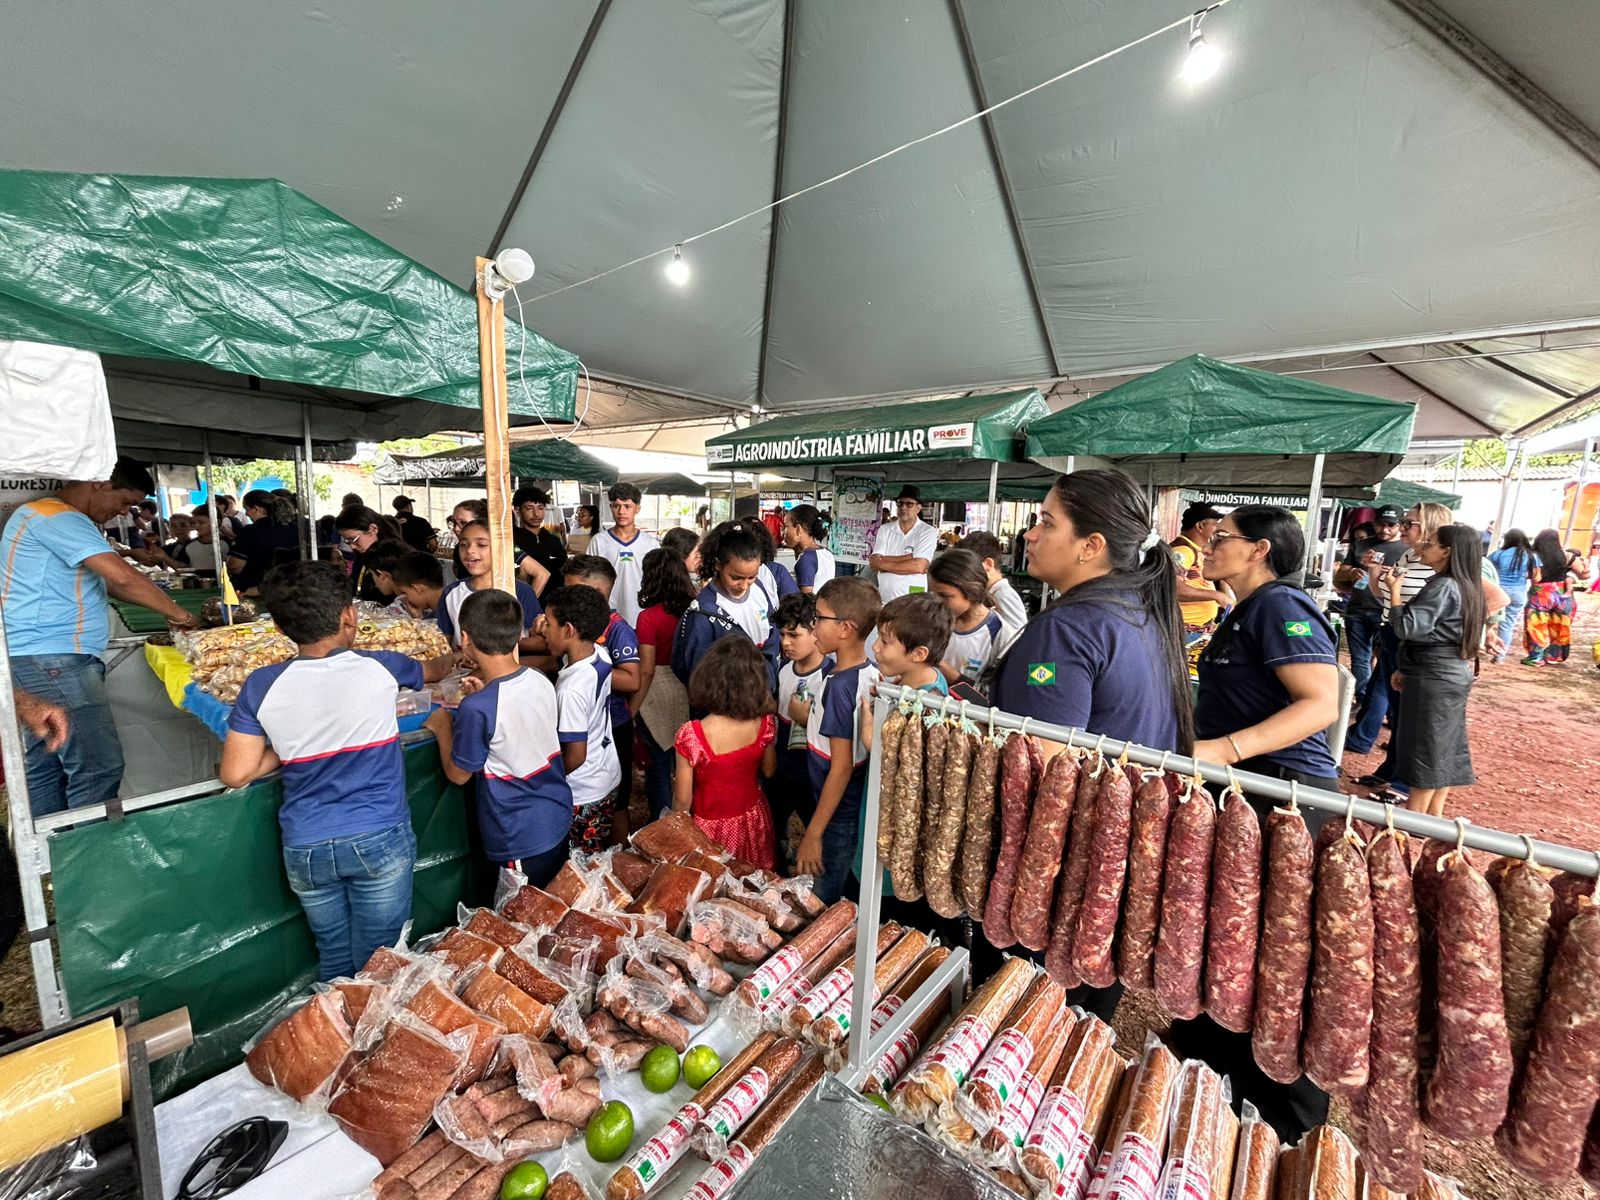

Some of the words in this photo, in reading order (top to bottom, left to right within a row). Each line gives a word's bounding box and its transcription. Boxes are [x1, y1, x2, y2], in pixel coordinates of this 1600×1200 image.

[933, 428, 967, 438] PROVE
[735, 437, 843, 461] AGROINDÚSTRIA
[845, 429, 925, 455] FAMILIAR
[1261, 496, 1308, 507] FAMILIAR
